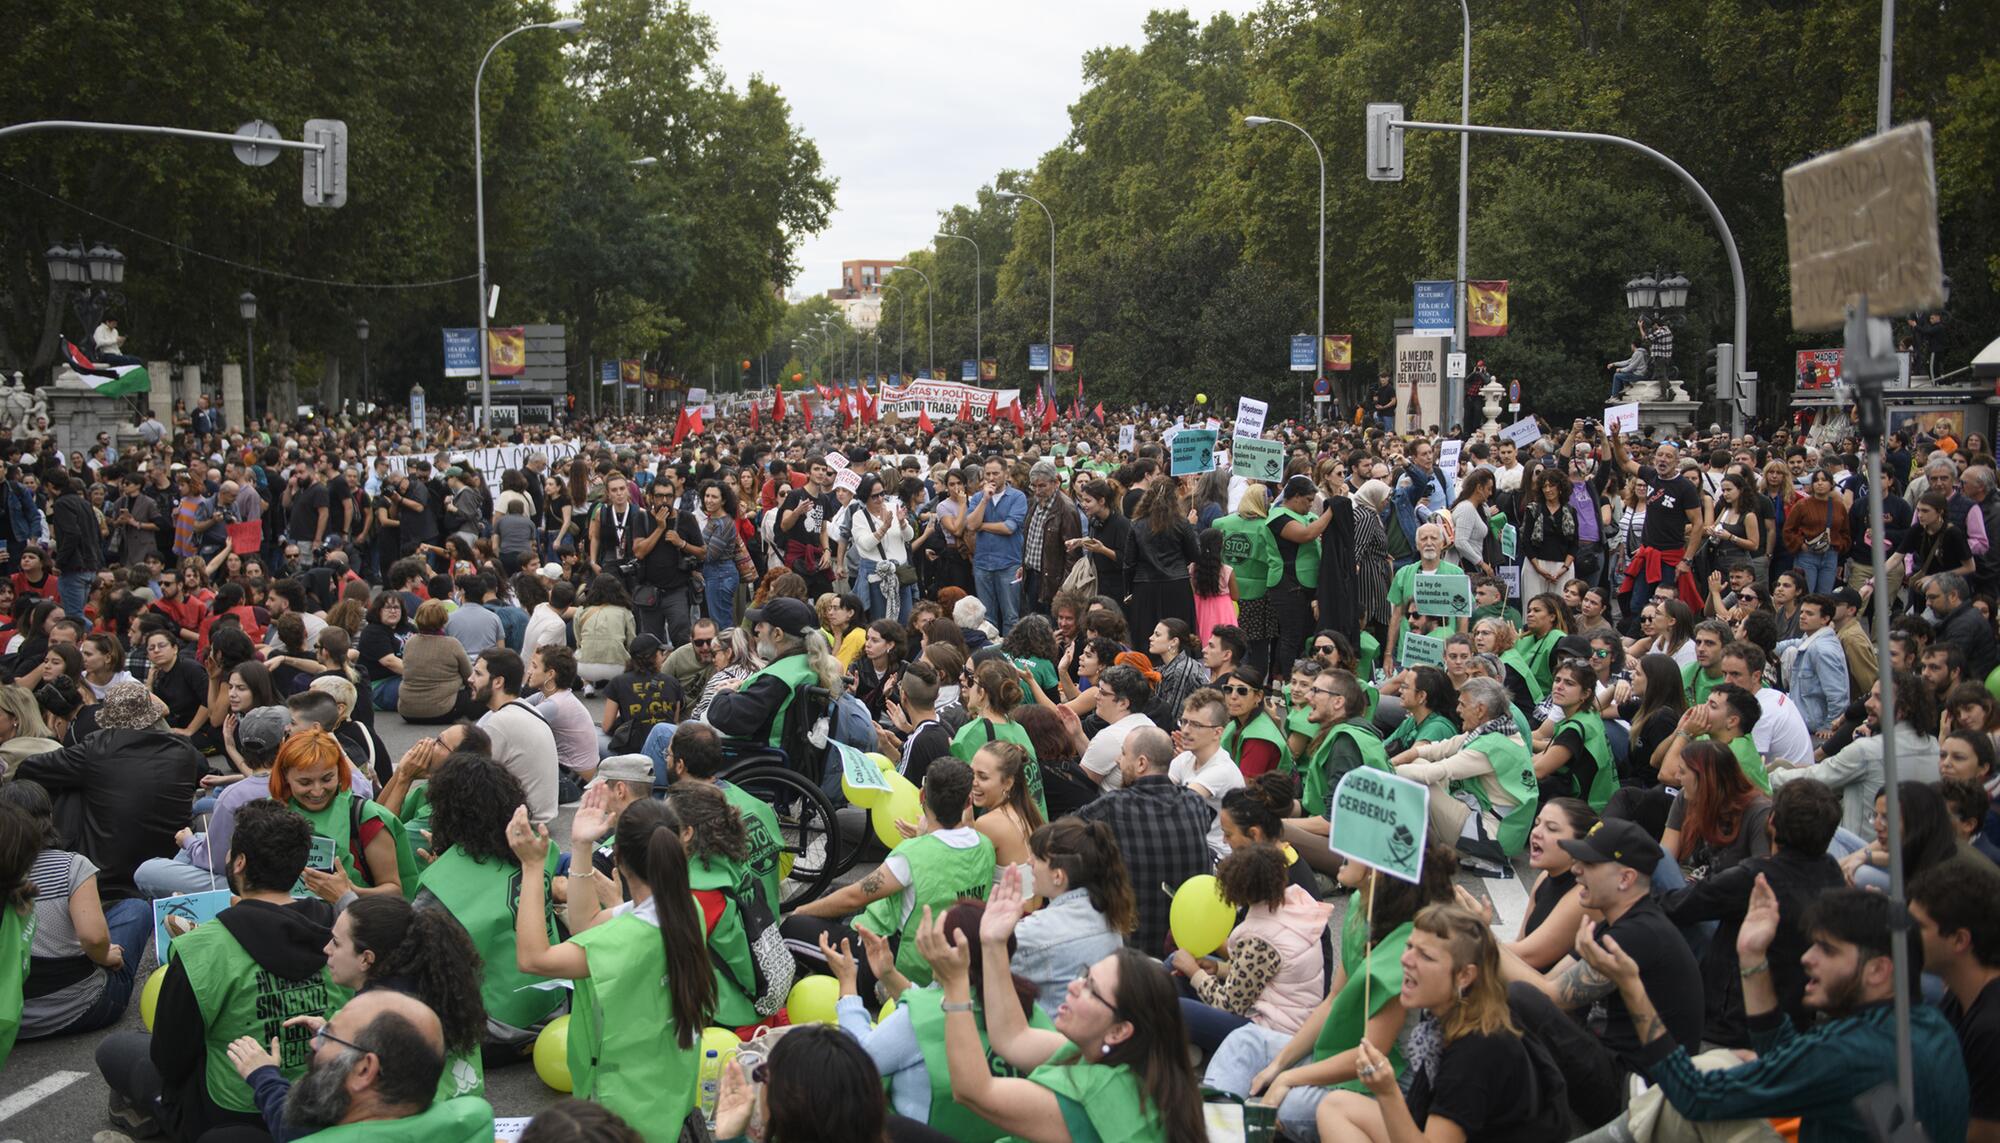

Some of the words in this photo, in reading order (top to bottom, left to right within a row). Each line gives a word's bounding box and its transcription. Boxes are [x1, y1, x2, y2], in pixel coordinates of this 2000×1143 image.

[1399, 350, 1406, 361] LA
[1408, 350, 1434, 361] MEJOR
[1400, 361, 1432, 372] CERVEZA
[1398, 373, 1407, 383] DEL
[1408, 372, 1437, 383] MUNDO
[1242, 443, 1266, 453] vivienda
[1267, 446, 1281, 455] para
[1225, 540, 1250, 552] STOP
[1424, 581, 1434, 590] ley
[1416, 589, 1441, 597] vivienda
[1429, 597, 1450, 605] mierda
[1343, 774, 1385, 800] GUERRA
[1386, 787, 1396, 803] A
[1338, 794, 1398, 826] CERBERUS
[256, 993, 281, 1019] SIN
